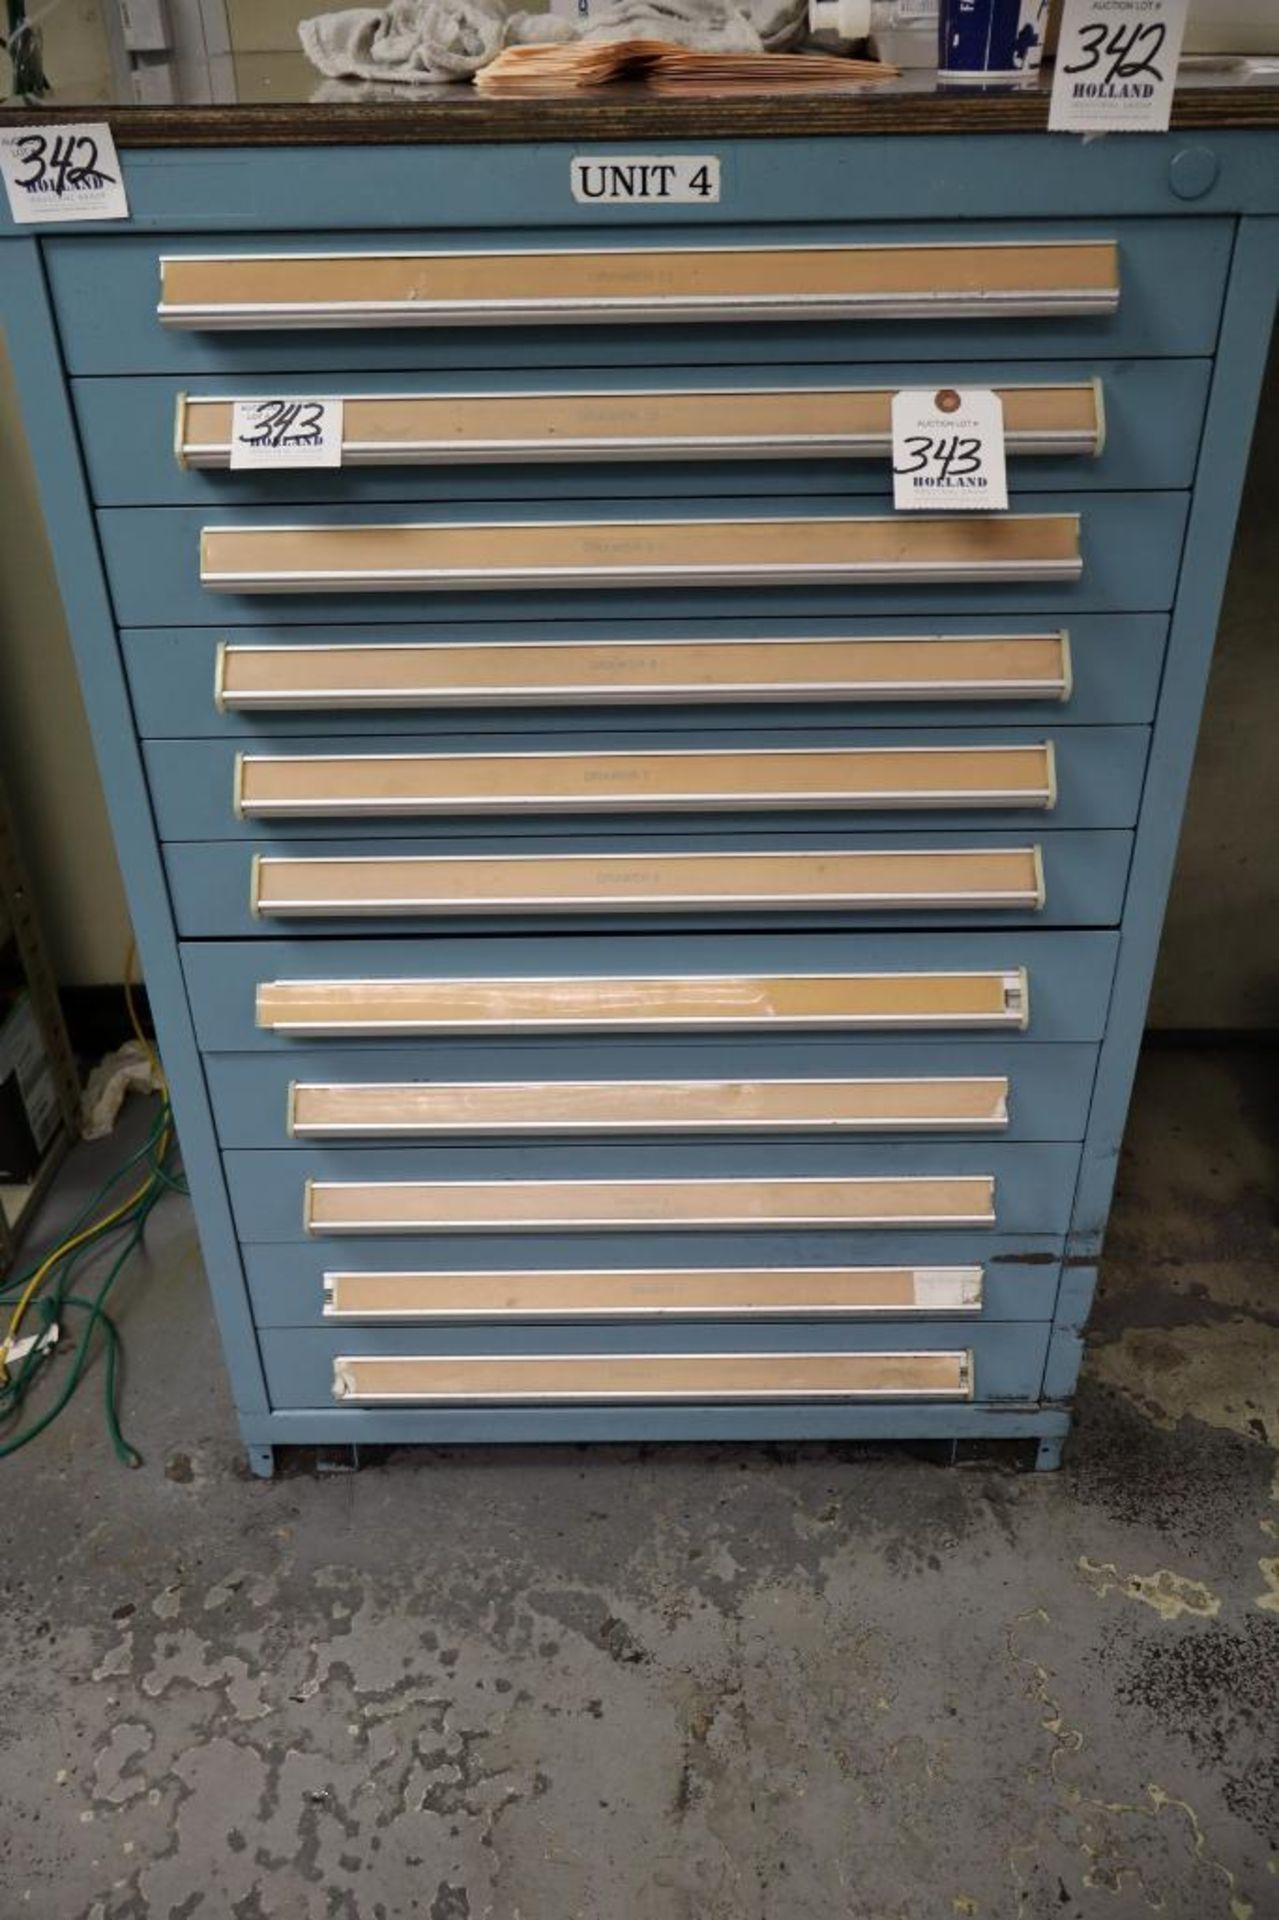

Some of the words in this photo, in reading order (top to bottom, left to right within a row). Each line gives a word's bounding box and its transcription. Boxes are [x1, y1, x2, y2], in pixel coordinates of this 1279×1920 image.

[1063, 23, 1166, 84] 342
[1072, 82, 1154, 98] HOLLAND
[14, 134, 116, 197] 342
[578, 165, 677, 197] UNIT
[688, 165, 713, 196] 4
[239, 400, 324, 447] 343
[893, 436, 982, 480] 343
[913, 476, 988, 487] HOLLAND
